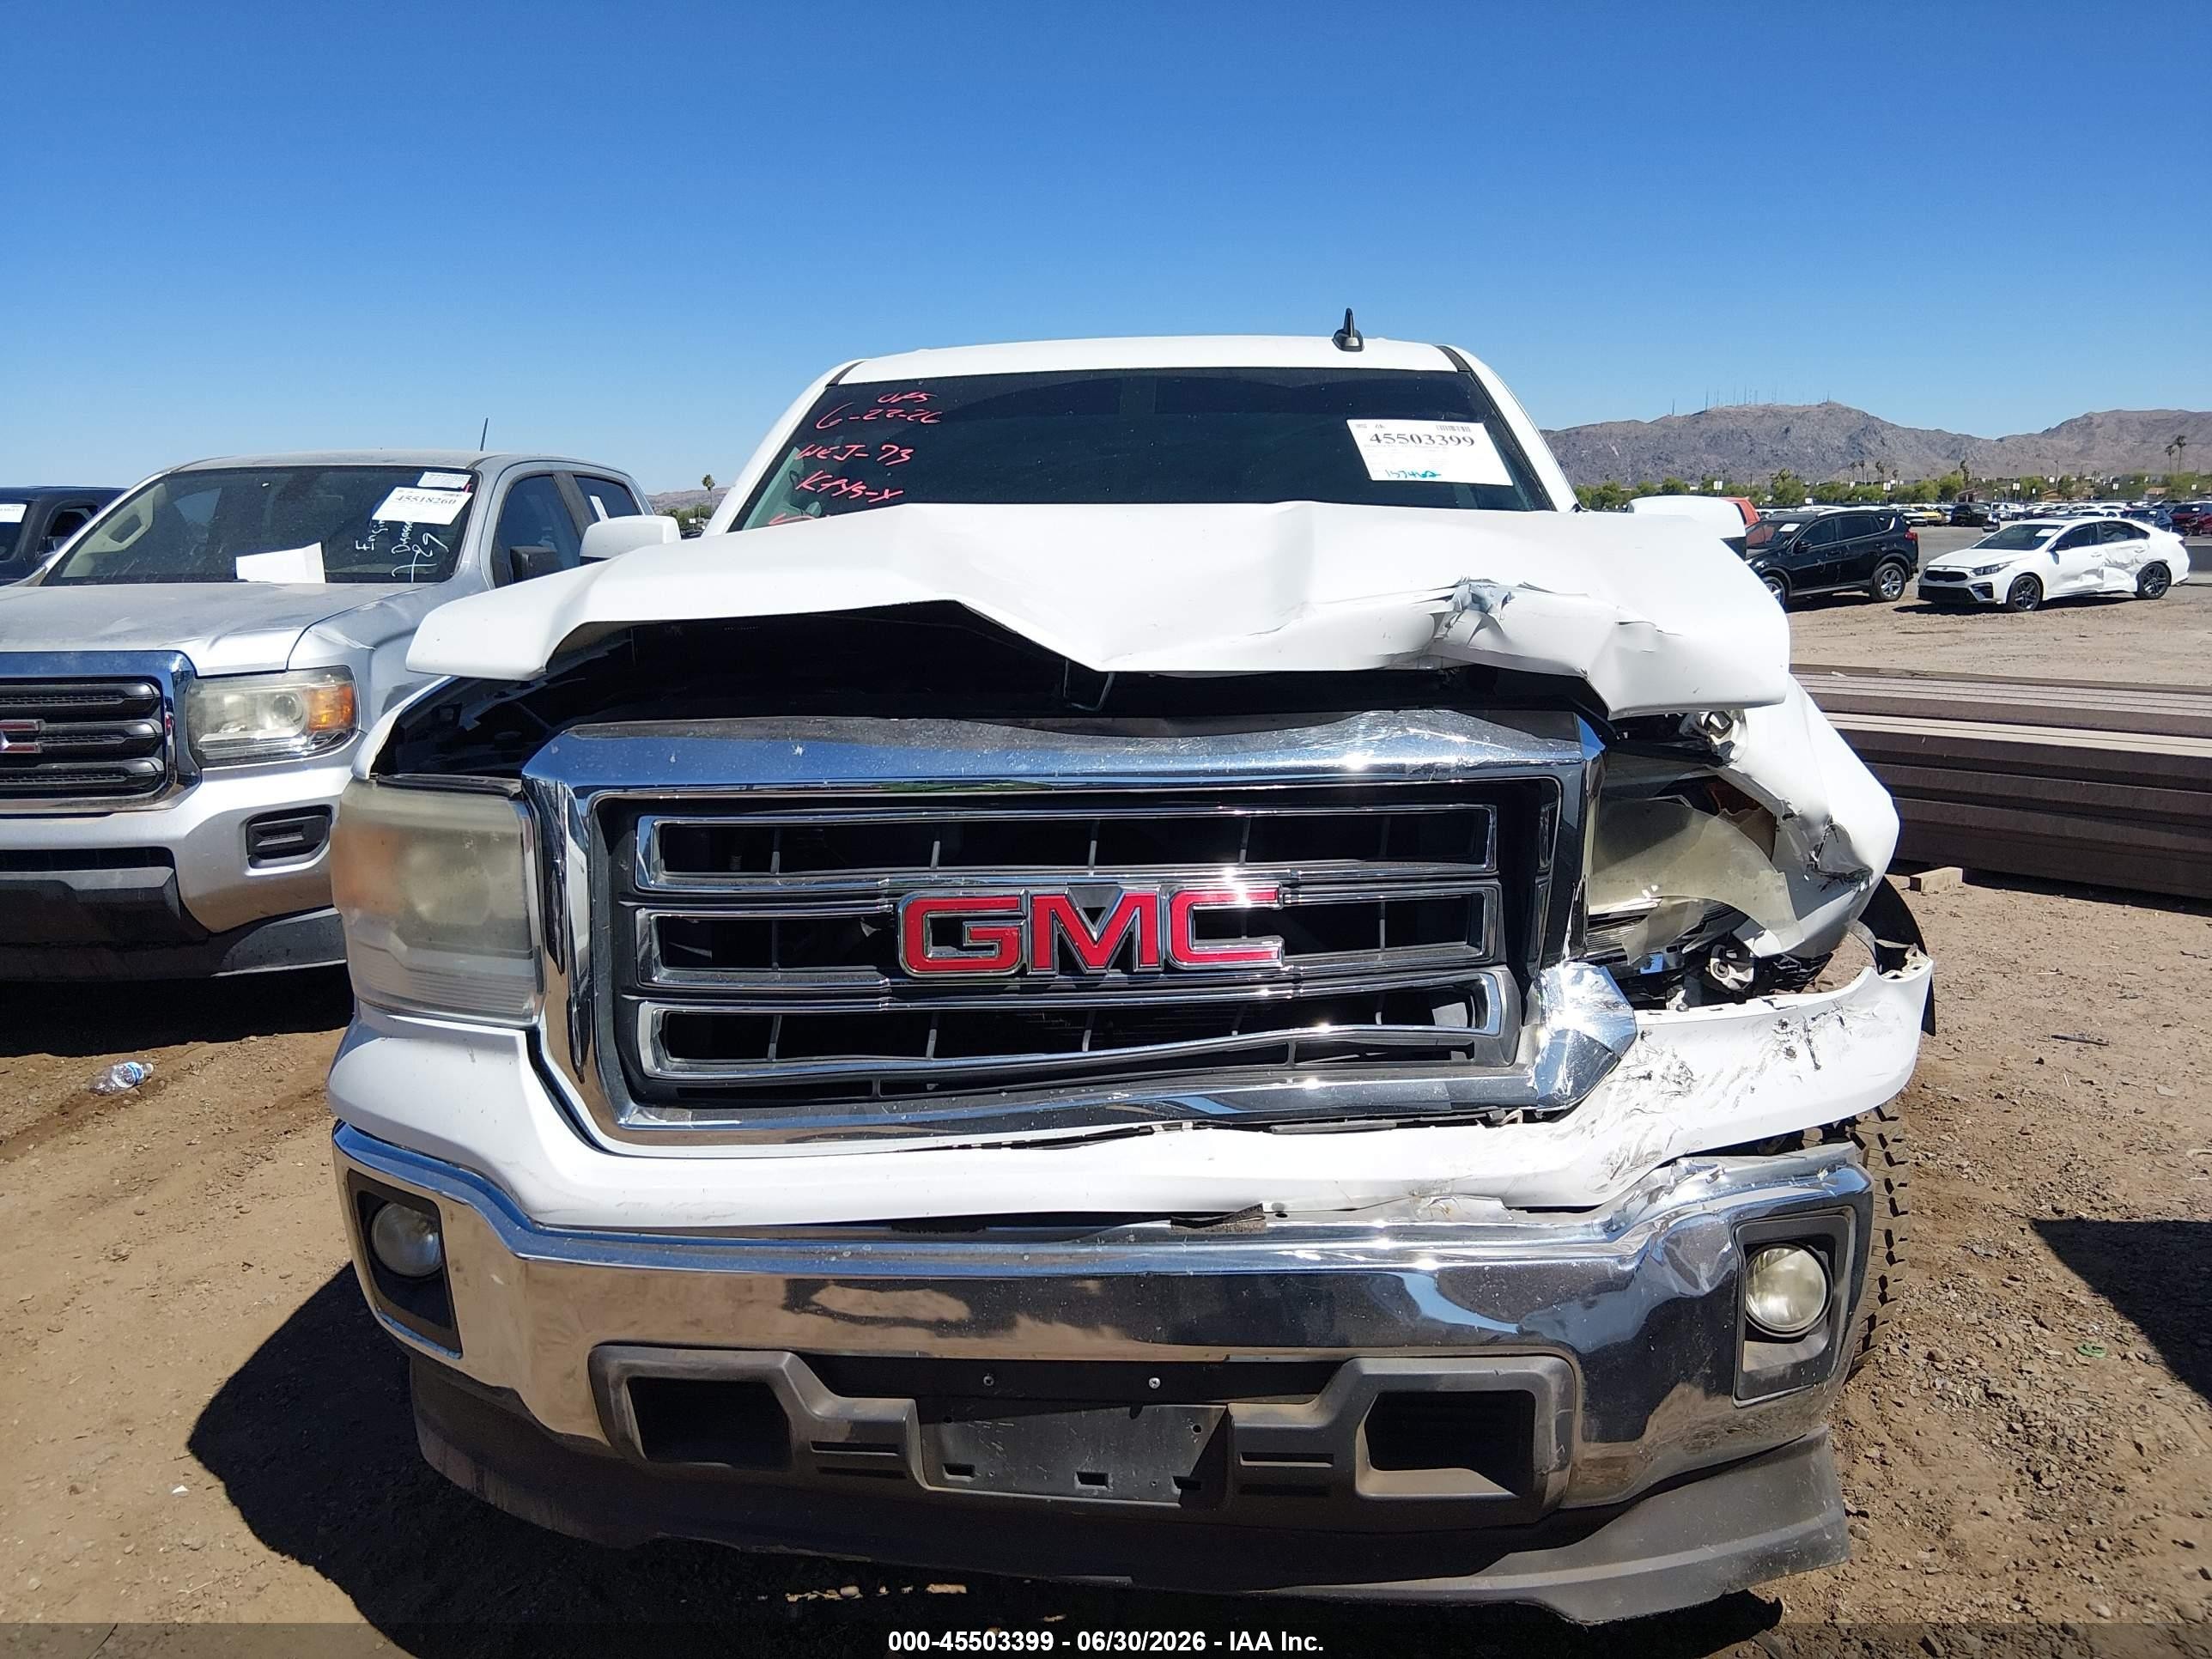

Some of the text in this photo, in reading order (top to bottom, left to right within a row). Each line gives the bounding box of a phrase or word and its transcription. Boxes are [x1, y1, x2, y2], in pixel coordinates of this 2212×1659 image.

[1369, 432, 1476, 447] 45503399
[395, 494, 458, 506] 45518260
[898, 884, 1285, 978] GMC
